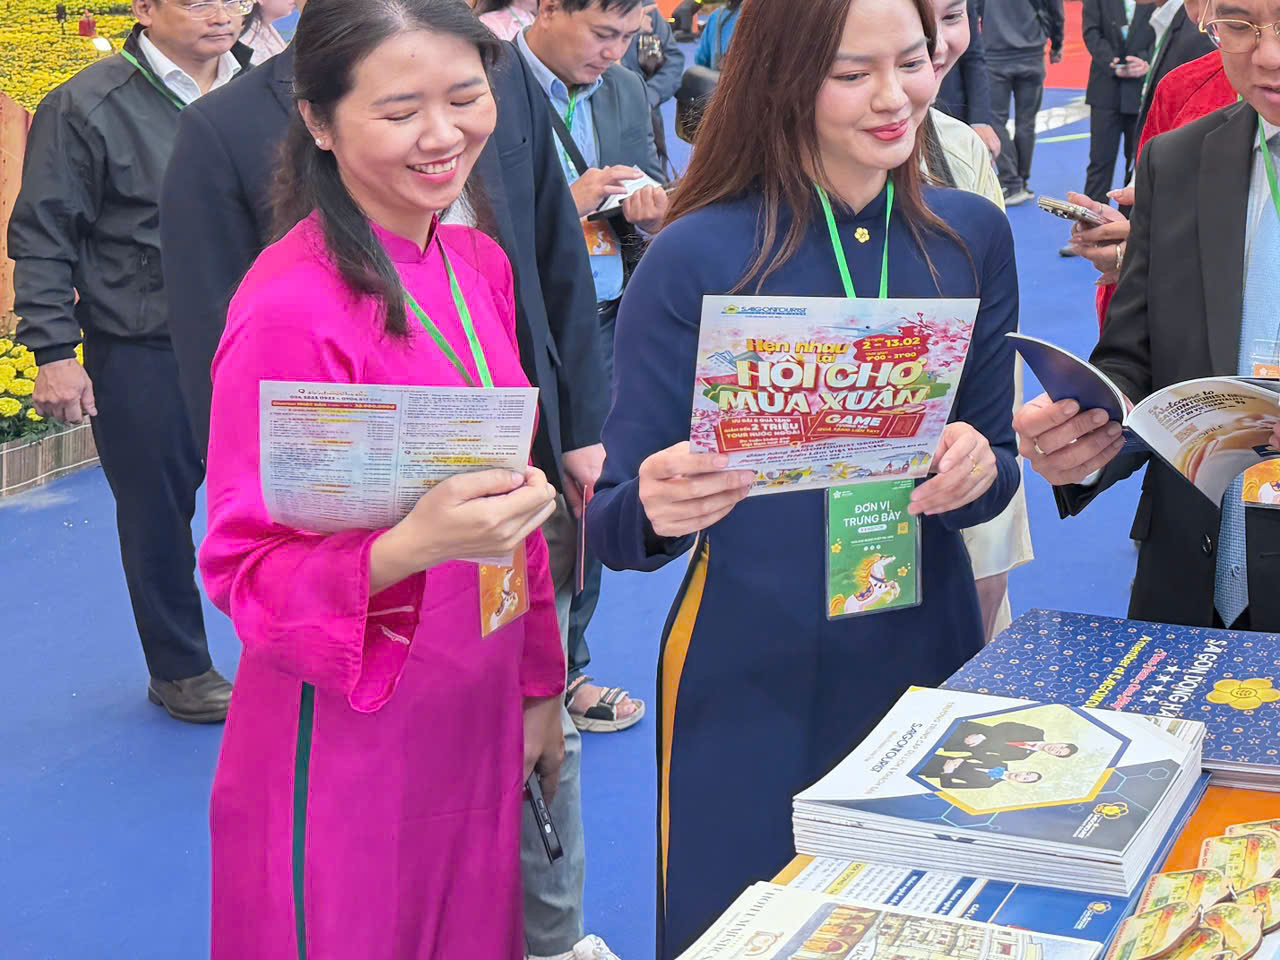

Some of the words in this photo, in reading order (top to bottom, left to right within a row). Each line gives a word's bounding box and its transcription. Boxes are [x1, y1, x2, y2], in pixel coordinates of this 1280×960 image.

[746, 338, 790, 354] Hẹn
[795, 339, 850, 354] nhau
[863, 341, 871, 349] 2
[885, 336, 921, 347] 13.02
[736, 354, 818, 392] HỘI
[825, 357, 928, 390] CHỢ
[718, 386, 811, 414] MÙA
[821, 385, 930, 411] XUÂN
[751, 423, 760, 432] 2
[761, 421, 799, 432] TRIỆU
[825, 414, 882, 427] GAME
[855, 502, 877, 513] ĐƠN
[880, 500, 890, 512] VỊ
[843, 514, 880, 527] TRƯNG
[881, 509, 901, 522] BÀY
[1085, 672, 1121, 708] SAIGONTOU
